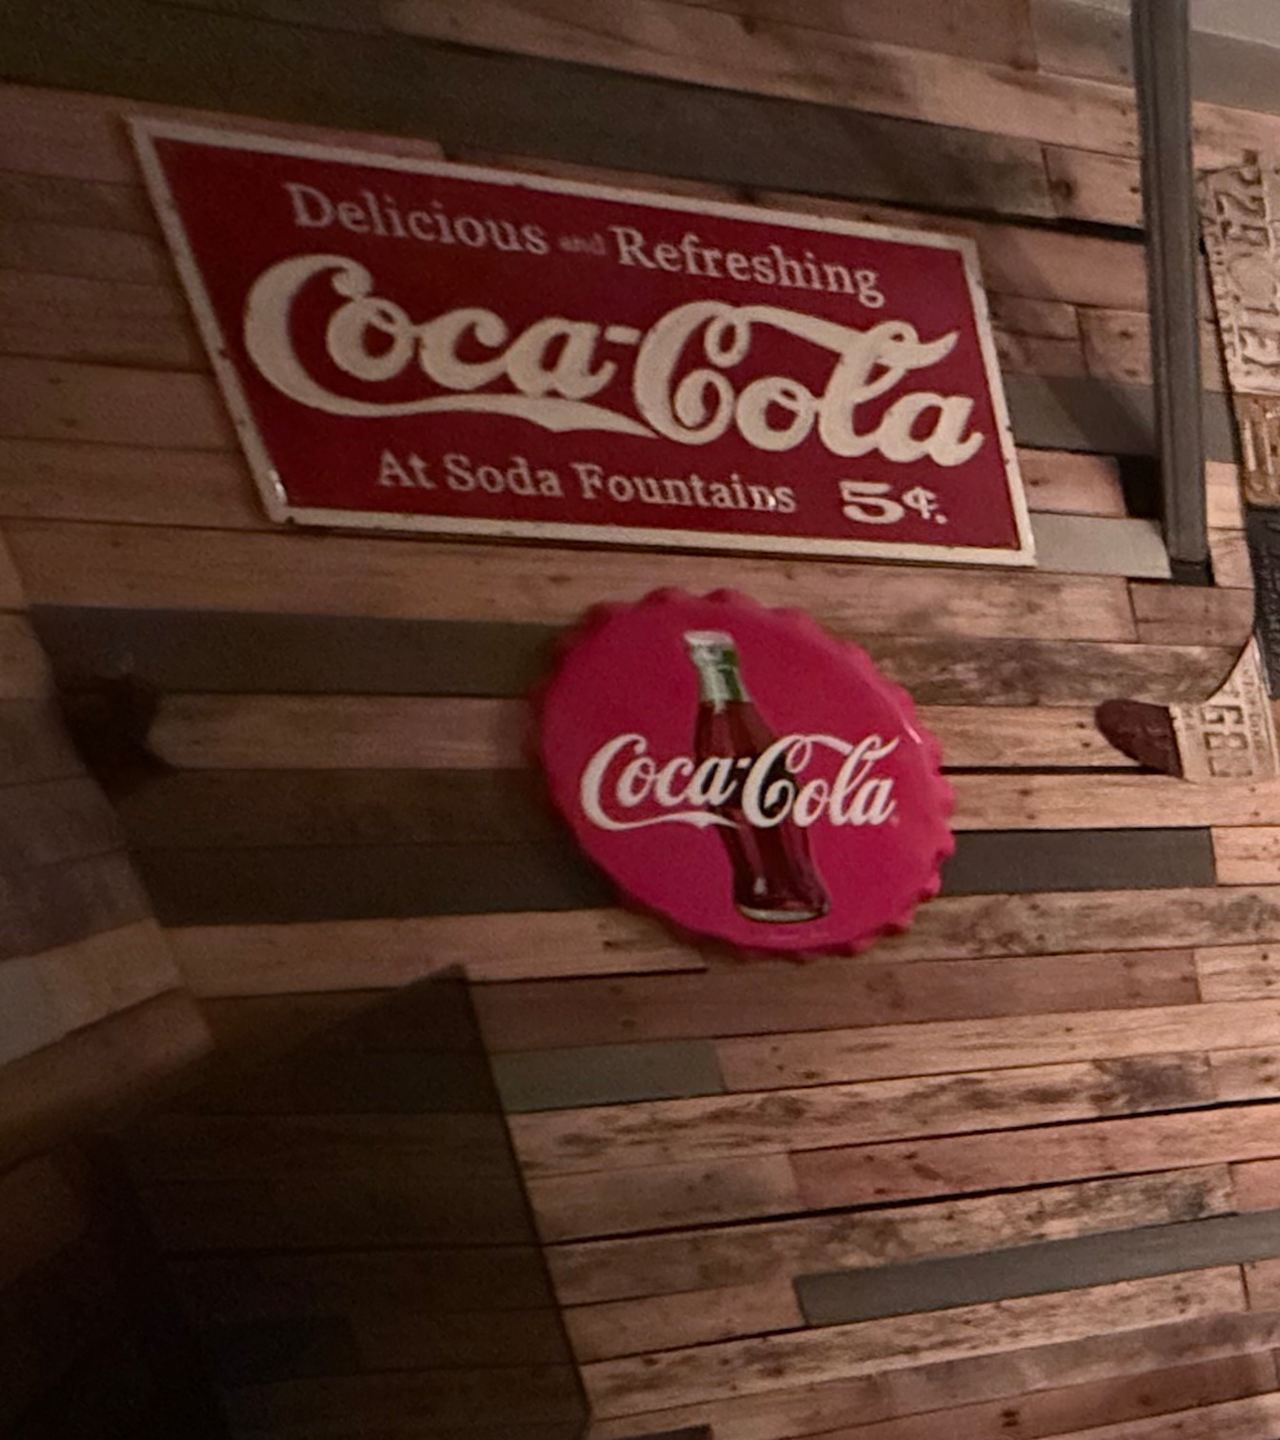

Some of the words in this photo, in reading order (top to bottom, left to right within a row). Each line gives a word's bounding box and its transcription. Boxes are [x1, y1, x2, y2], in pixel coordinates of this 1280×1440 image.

[284, 183, 550, 256] Delicious
[611, 226, 885, 308] Refreshing
[244, 254, 985, 468] Coca-Cola
[377, 451, 435, 490] At
[443, 454, 562, 499] Soda
[571, 462, 796, 515] Fountains
[580, 733, 899, 831] Coca-Cola
